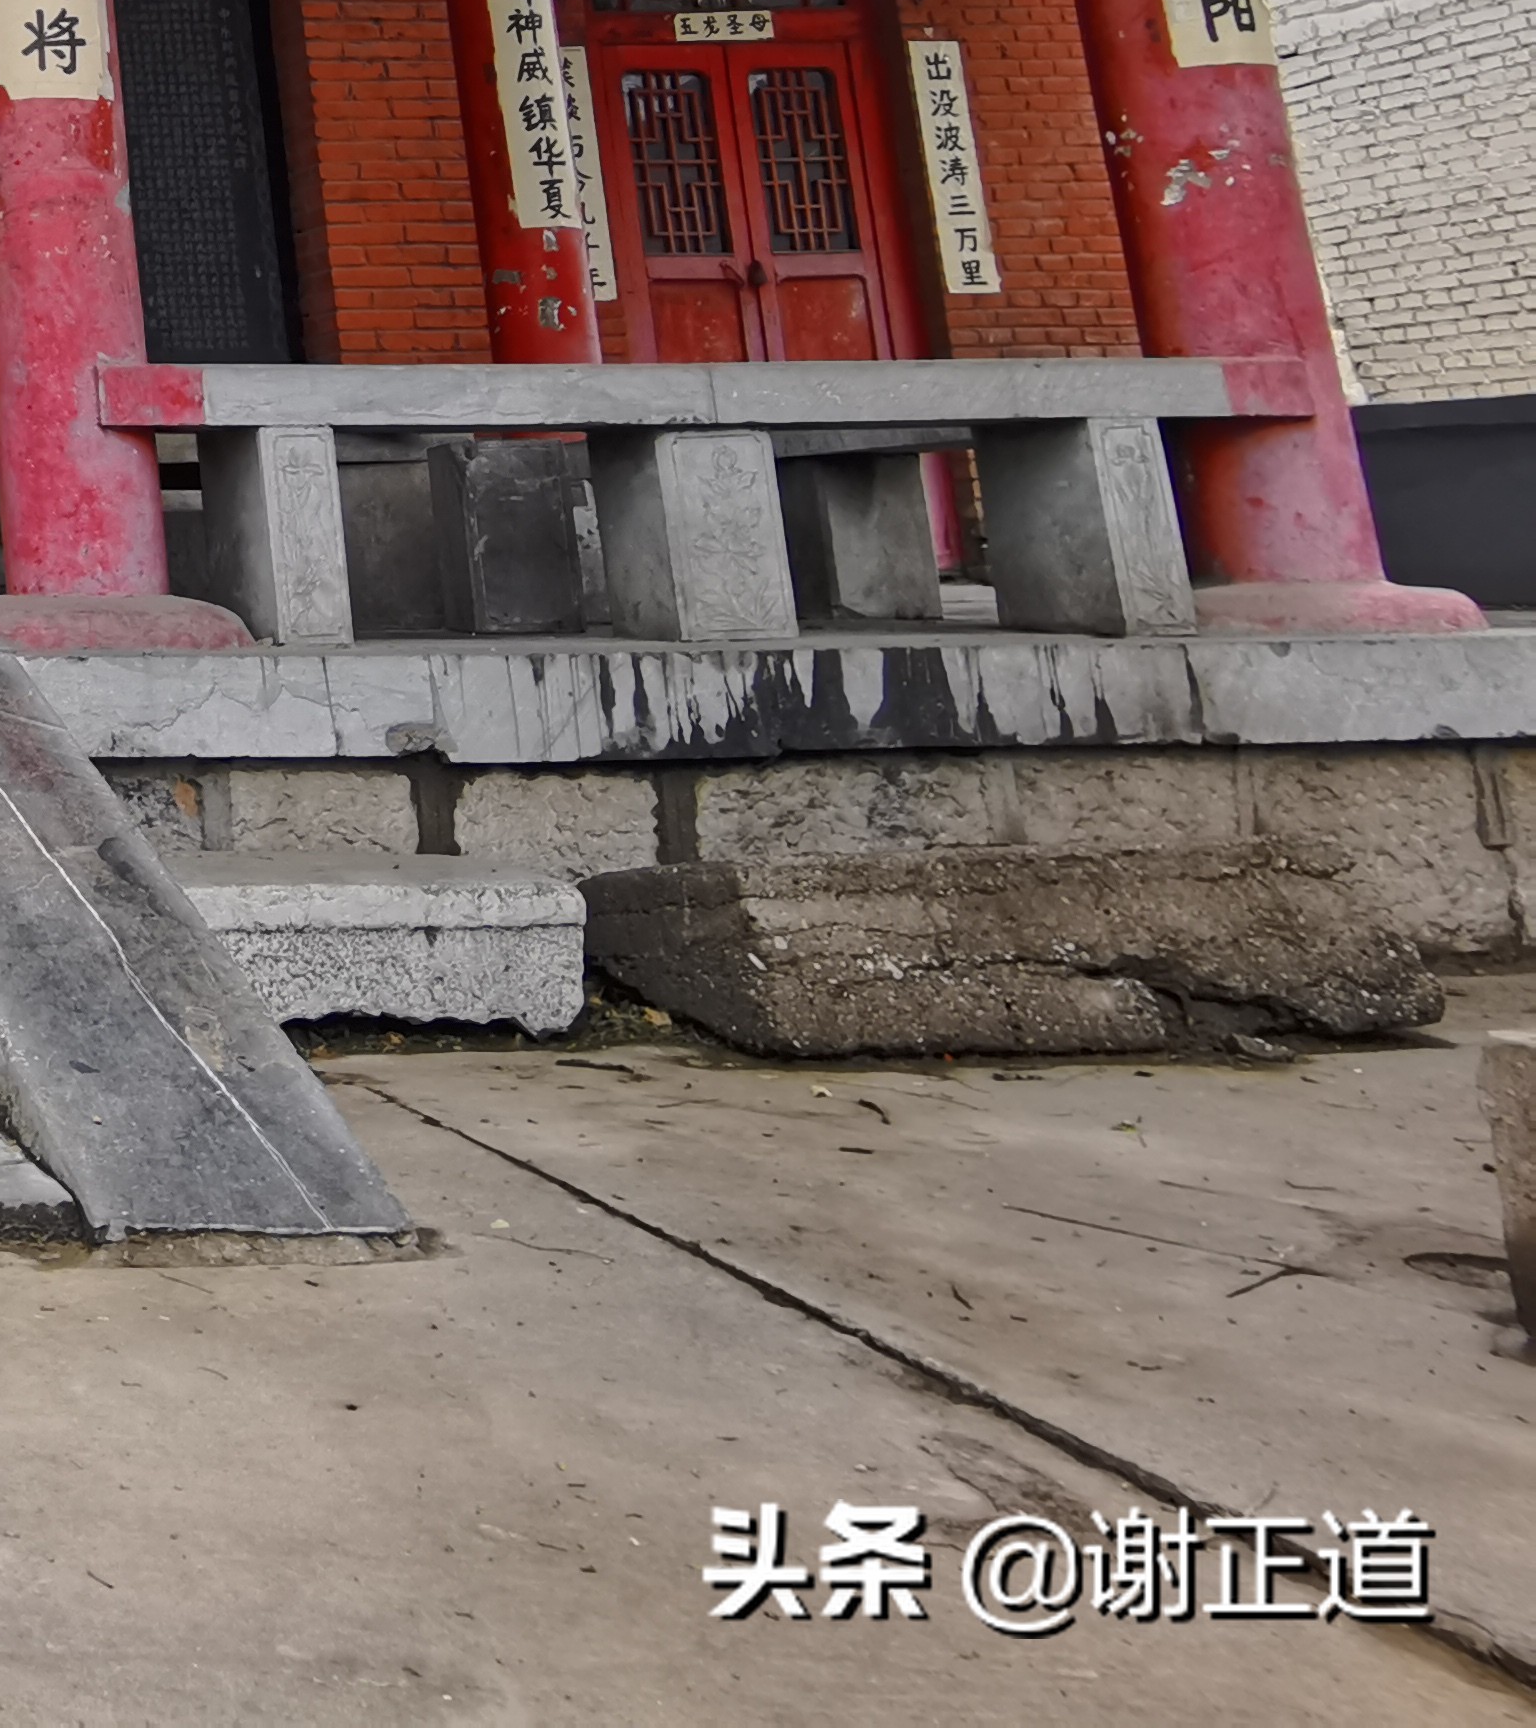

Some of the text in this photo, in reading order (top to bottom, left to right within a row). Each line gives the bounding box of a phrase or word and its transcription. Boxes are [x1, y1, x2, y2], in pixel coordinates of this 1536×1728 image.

[680, 13, 770, 38] 五龙圣母
[924, 54, 989, 287] 出没波涛三万里
